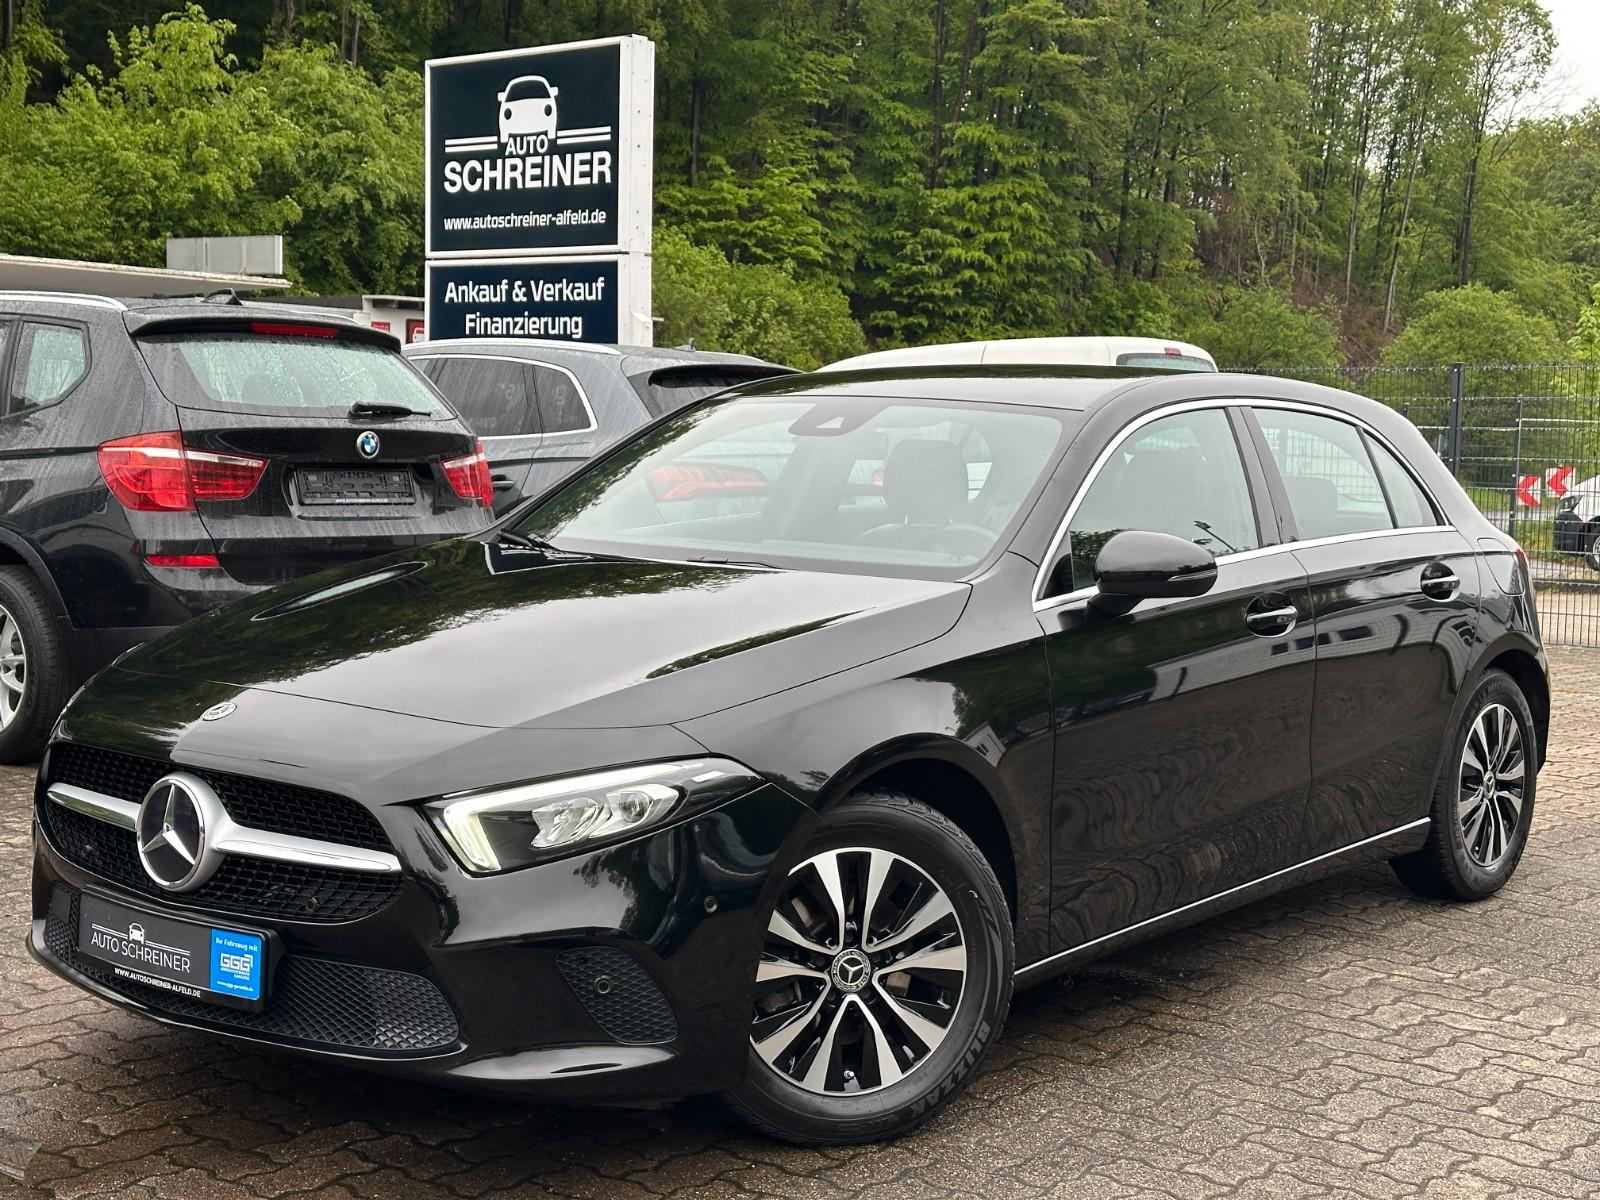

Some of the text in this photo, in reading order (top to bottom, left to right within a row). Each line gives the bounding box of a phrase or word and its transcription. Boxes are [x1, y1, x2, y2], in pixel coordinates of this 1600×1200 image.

[505, 134, 549, 156] AUTO
[444, 151, 611, 193] SCHREINER
[444, 209, 606, 230] www.autoschreiner-alfeld.de
[445, 277, 605, 303] Ankauf & Verkauf
[465, 311, 582, 338] Finanzierung
[91, 931, 190, 973] AUTO SCHREINER
[114, 967, 201, 998] WWW.AUTOSCHREINER-ALFELD.DE
